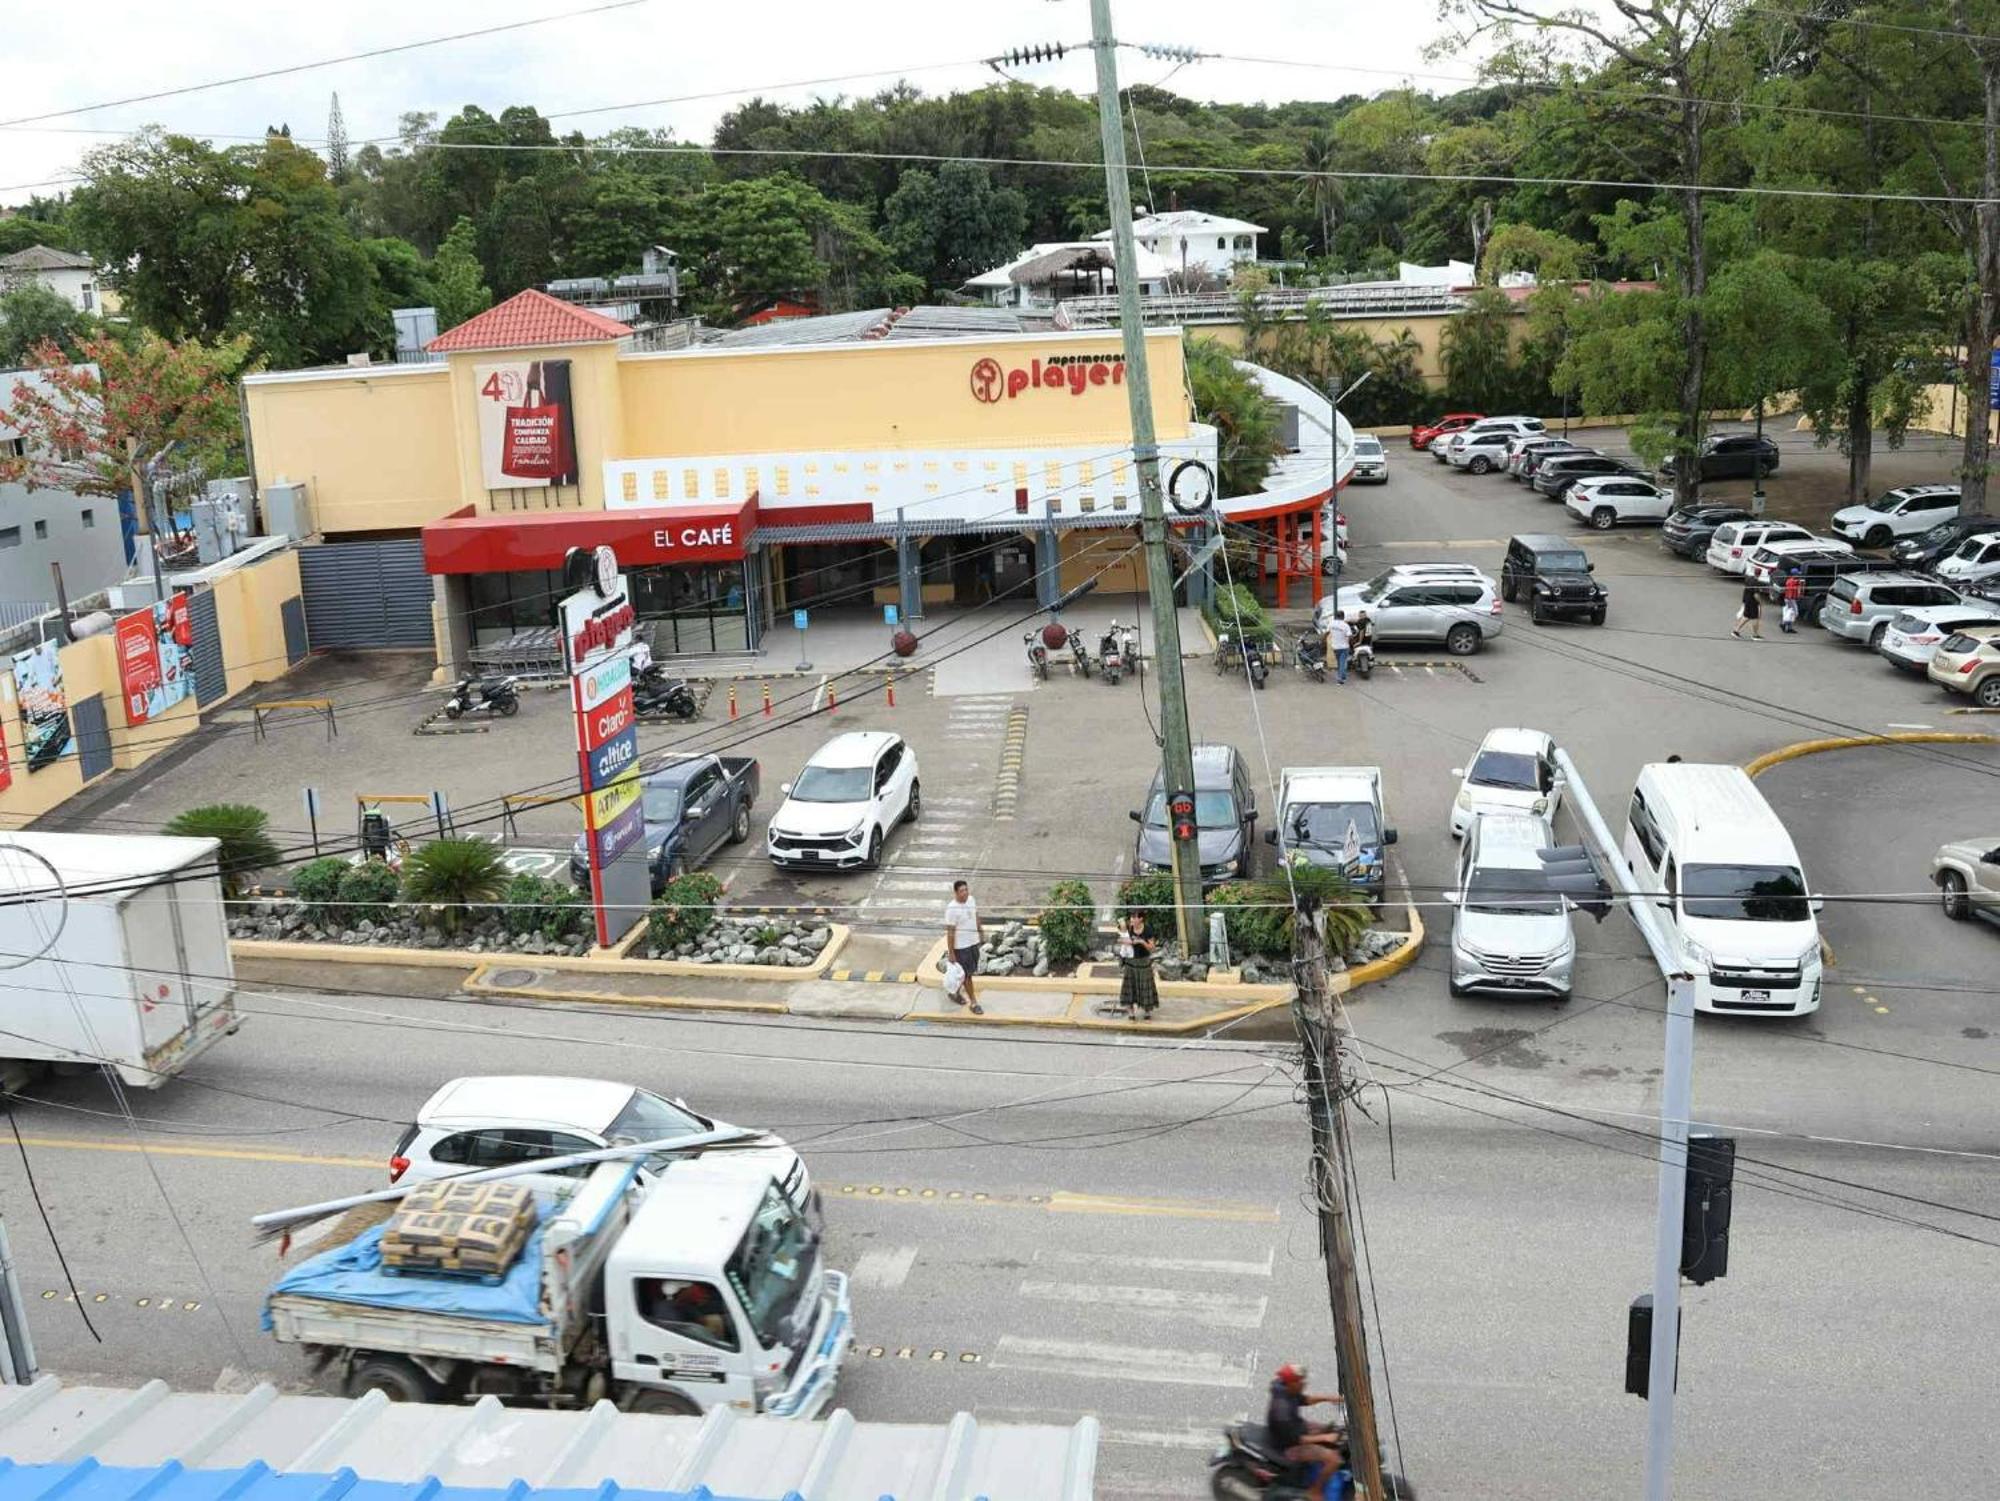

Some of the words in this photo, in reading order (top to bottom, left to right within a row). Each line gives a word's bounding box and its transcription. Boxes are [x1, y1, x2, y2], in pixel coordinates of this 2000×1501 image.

[1008, 359, 1127, 398] player
[511, 415, 554, 427] TRADICIÓN
[515, 436, 547, 445] CALIDAD
[654, 530, 674, 547] EL
[681, 522, 732, 546] CAFÉ
[598, 703, 627, 738] Claro
[599, 738, 632, 777] altice
